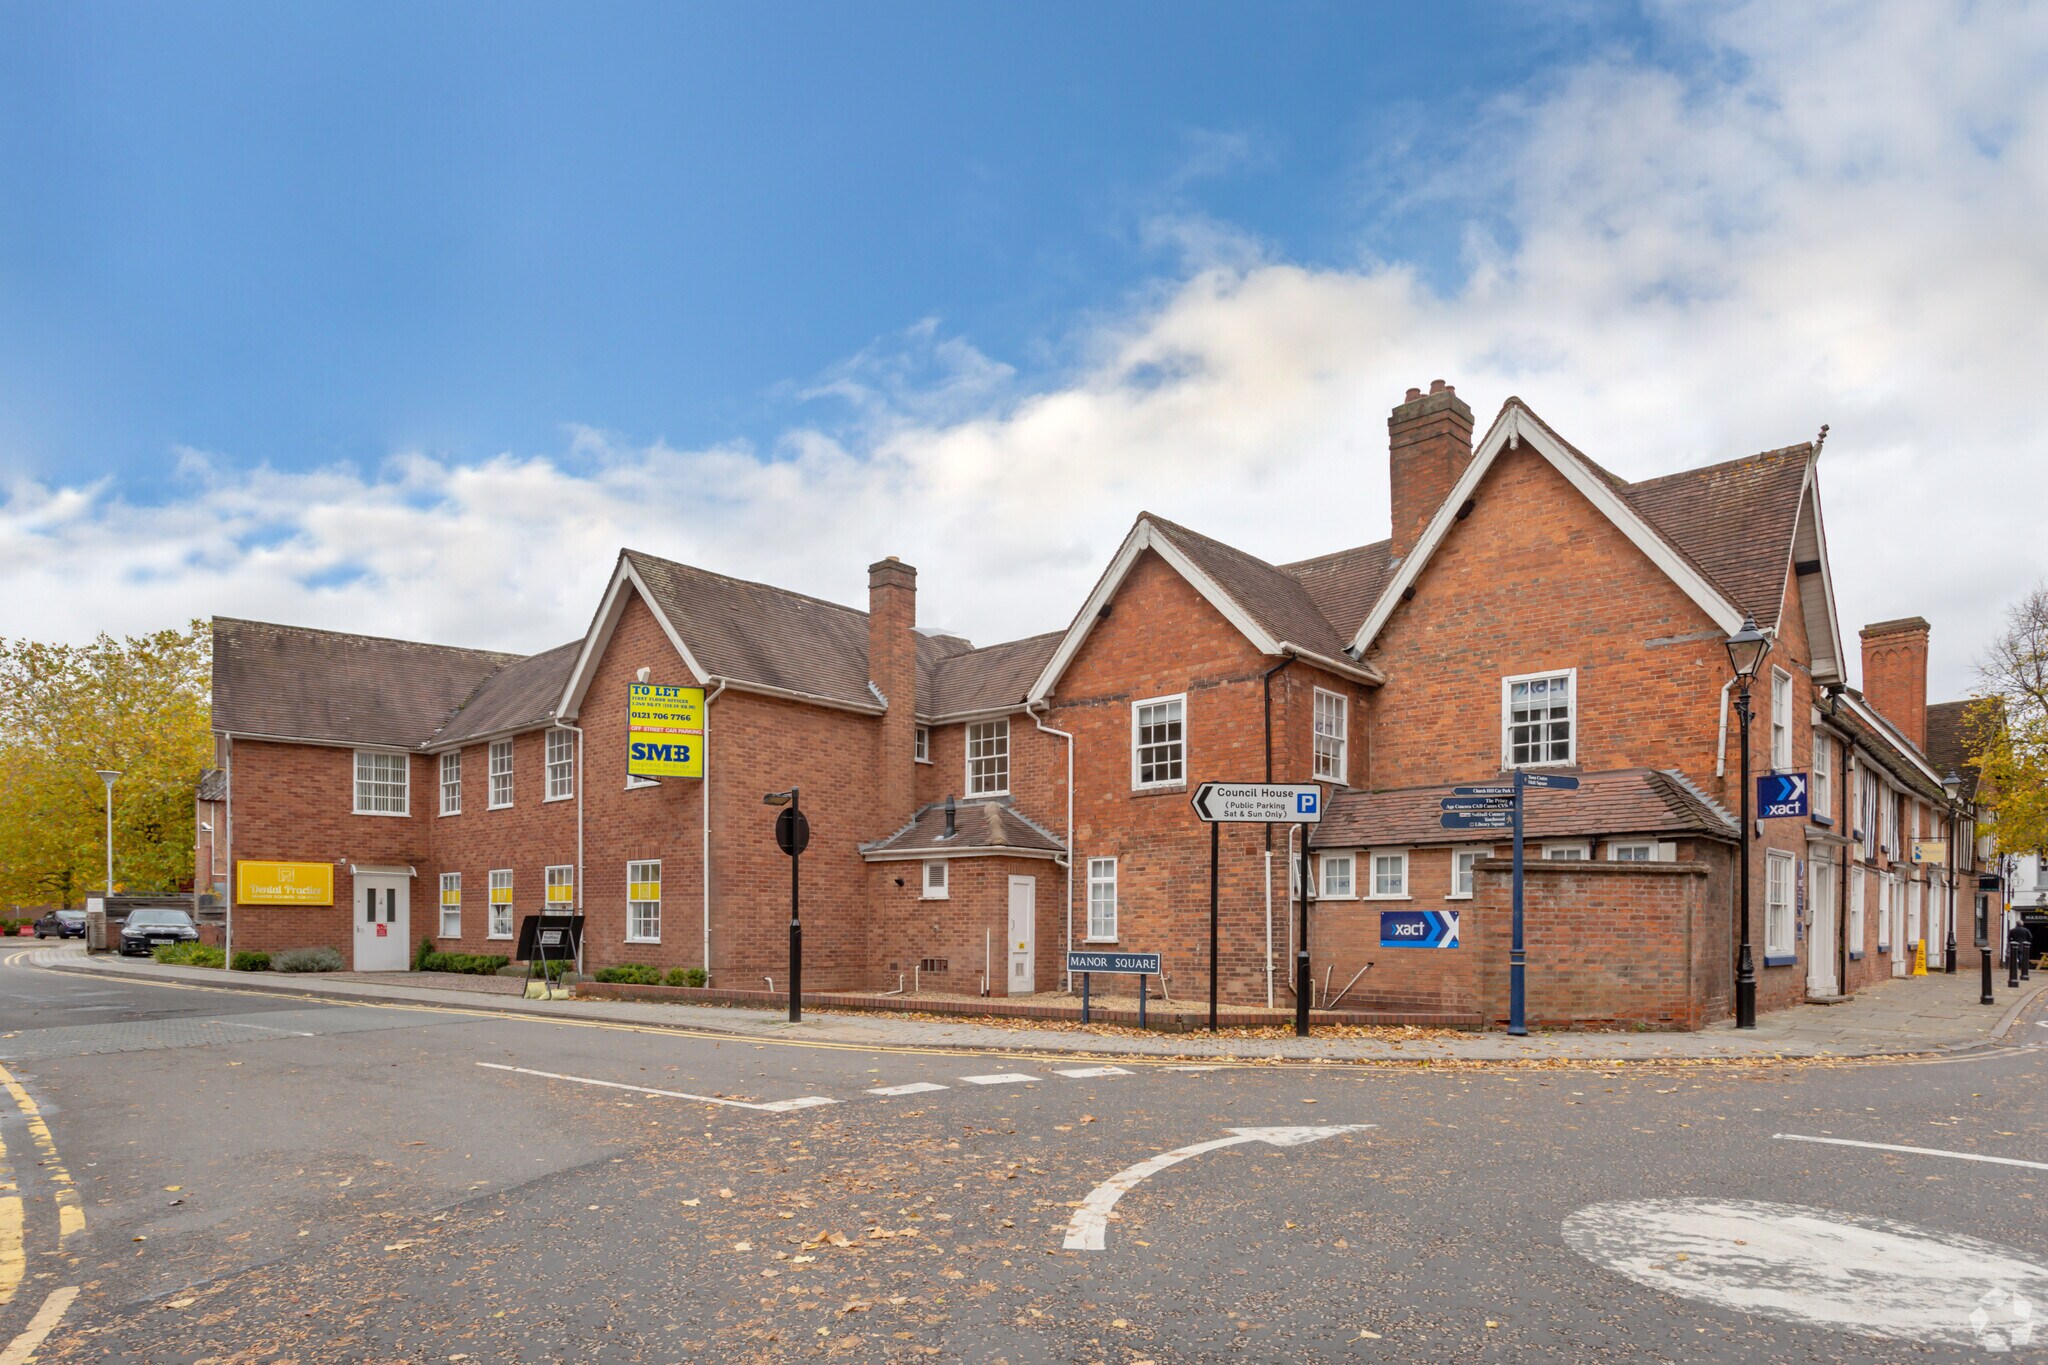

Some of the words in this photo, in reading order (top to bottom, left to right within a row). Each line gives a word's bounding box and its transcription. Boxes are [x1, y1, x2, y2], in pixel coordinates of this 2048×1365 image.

[633, 686, 650, 695] TO
[655, 687, 680, 697] LET
[632, 711, 650, 719] 0121
[631, 742, 690, 762] SMB
[1217, 787, 1257, 797] Council
[1261, 788, 1294, 798] House
[1225, 801, 1254, 809] (Public
[1256, 802, 1285, 810] Parking
[1301, 795, 1314, 812] P
[1769, 801, 1801, 815] xact
[1224, 810, 1237, 818] Sat
[1264, 811, 1288, 819] Only)
[249, 883, 282, 894] Dental
[284, 884, 322, 895] Practice
[1395, 921, 1425, 936] xact
[1070, 956, 1108, 967] MANOR
[1115, 958, 1156, 969] SQUARE
